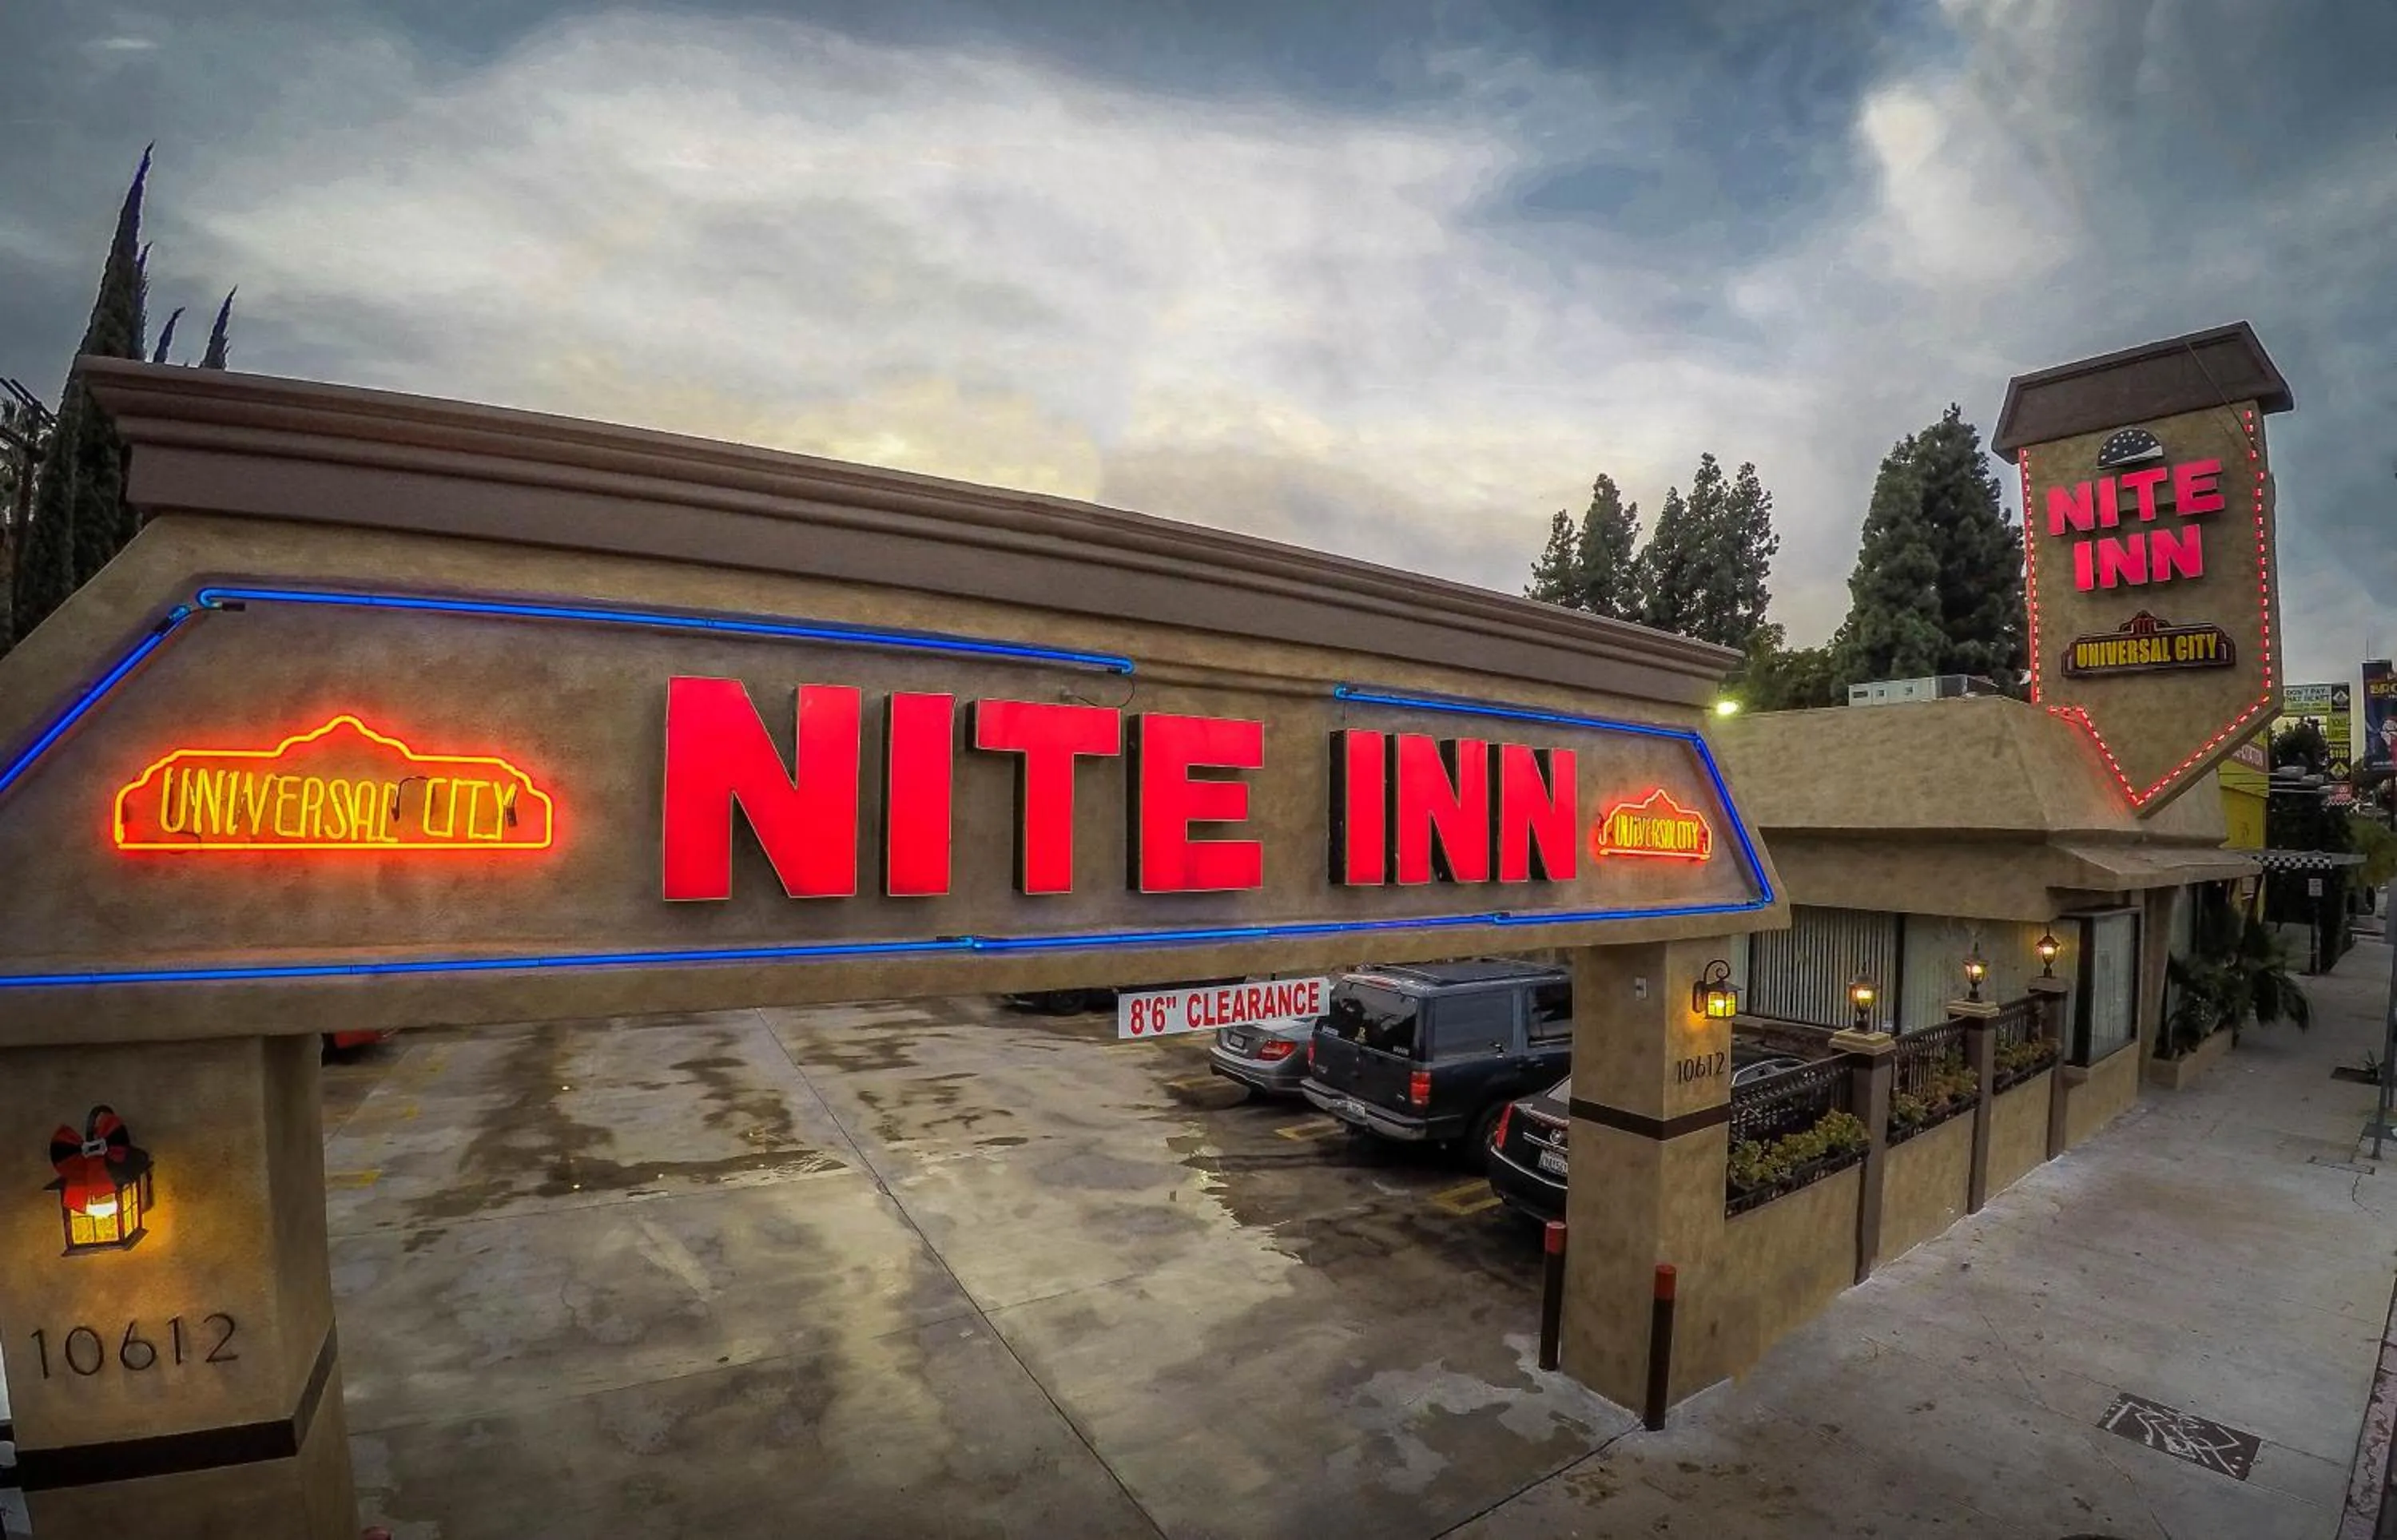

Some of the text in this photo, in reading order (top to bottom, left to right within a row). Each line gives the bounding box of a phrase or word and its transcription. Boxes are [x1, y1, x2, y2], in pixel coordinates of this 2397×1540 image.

[2046, 458, 2225, 536] NITE
[2073, 524, 2204, 592] INN
[2076, 632, 2218, 669] UNIVERSAL CITY
[160, 767, 516, 843] UNIVERSAL CITY
[662, 676, 1577, 902] NITE INN
[1130, 982, 1319, 1035] 8'6" CLEARANCE
[1677, 1051, 1725, 1083] 10612
[30, 1312, 239, 1380] 10612
